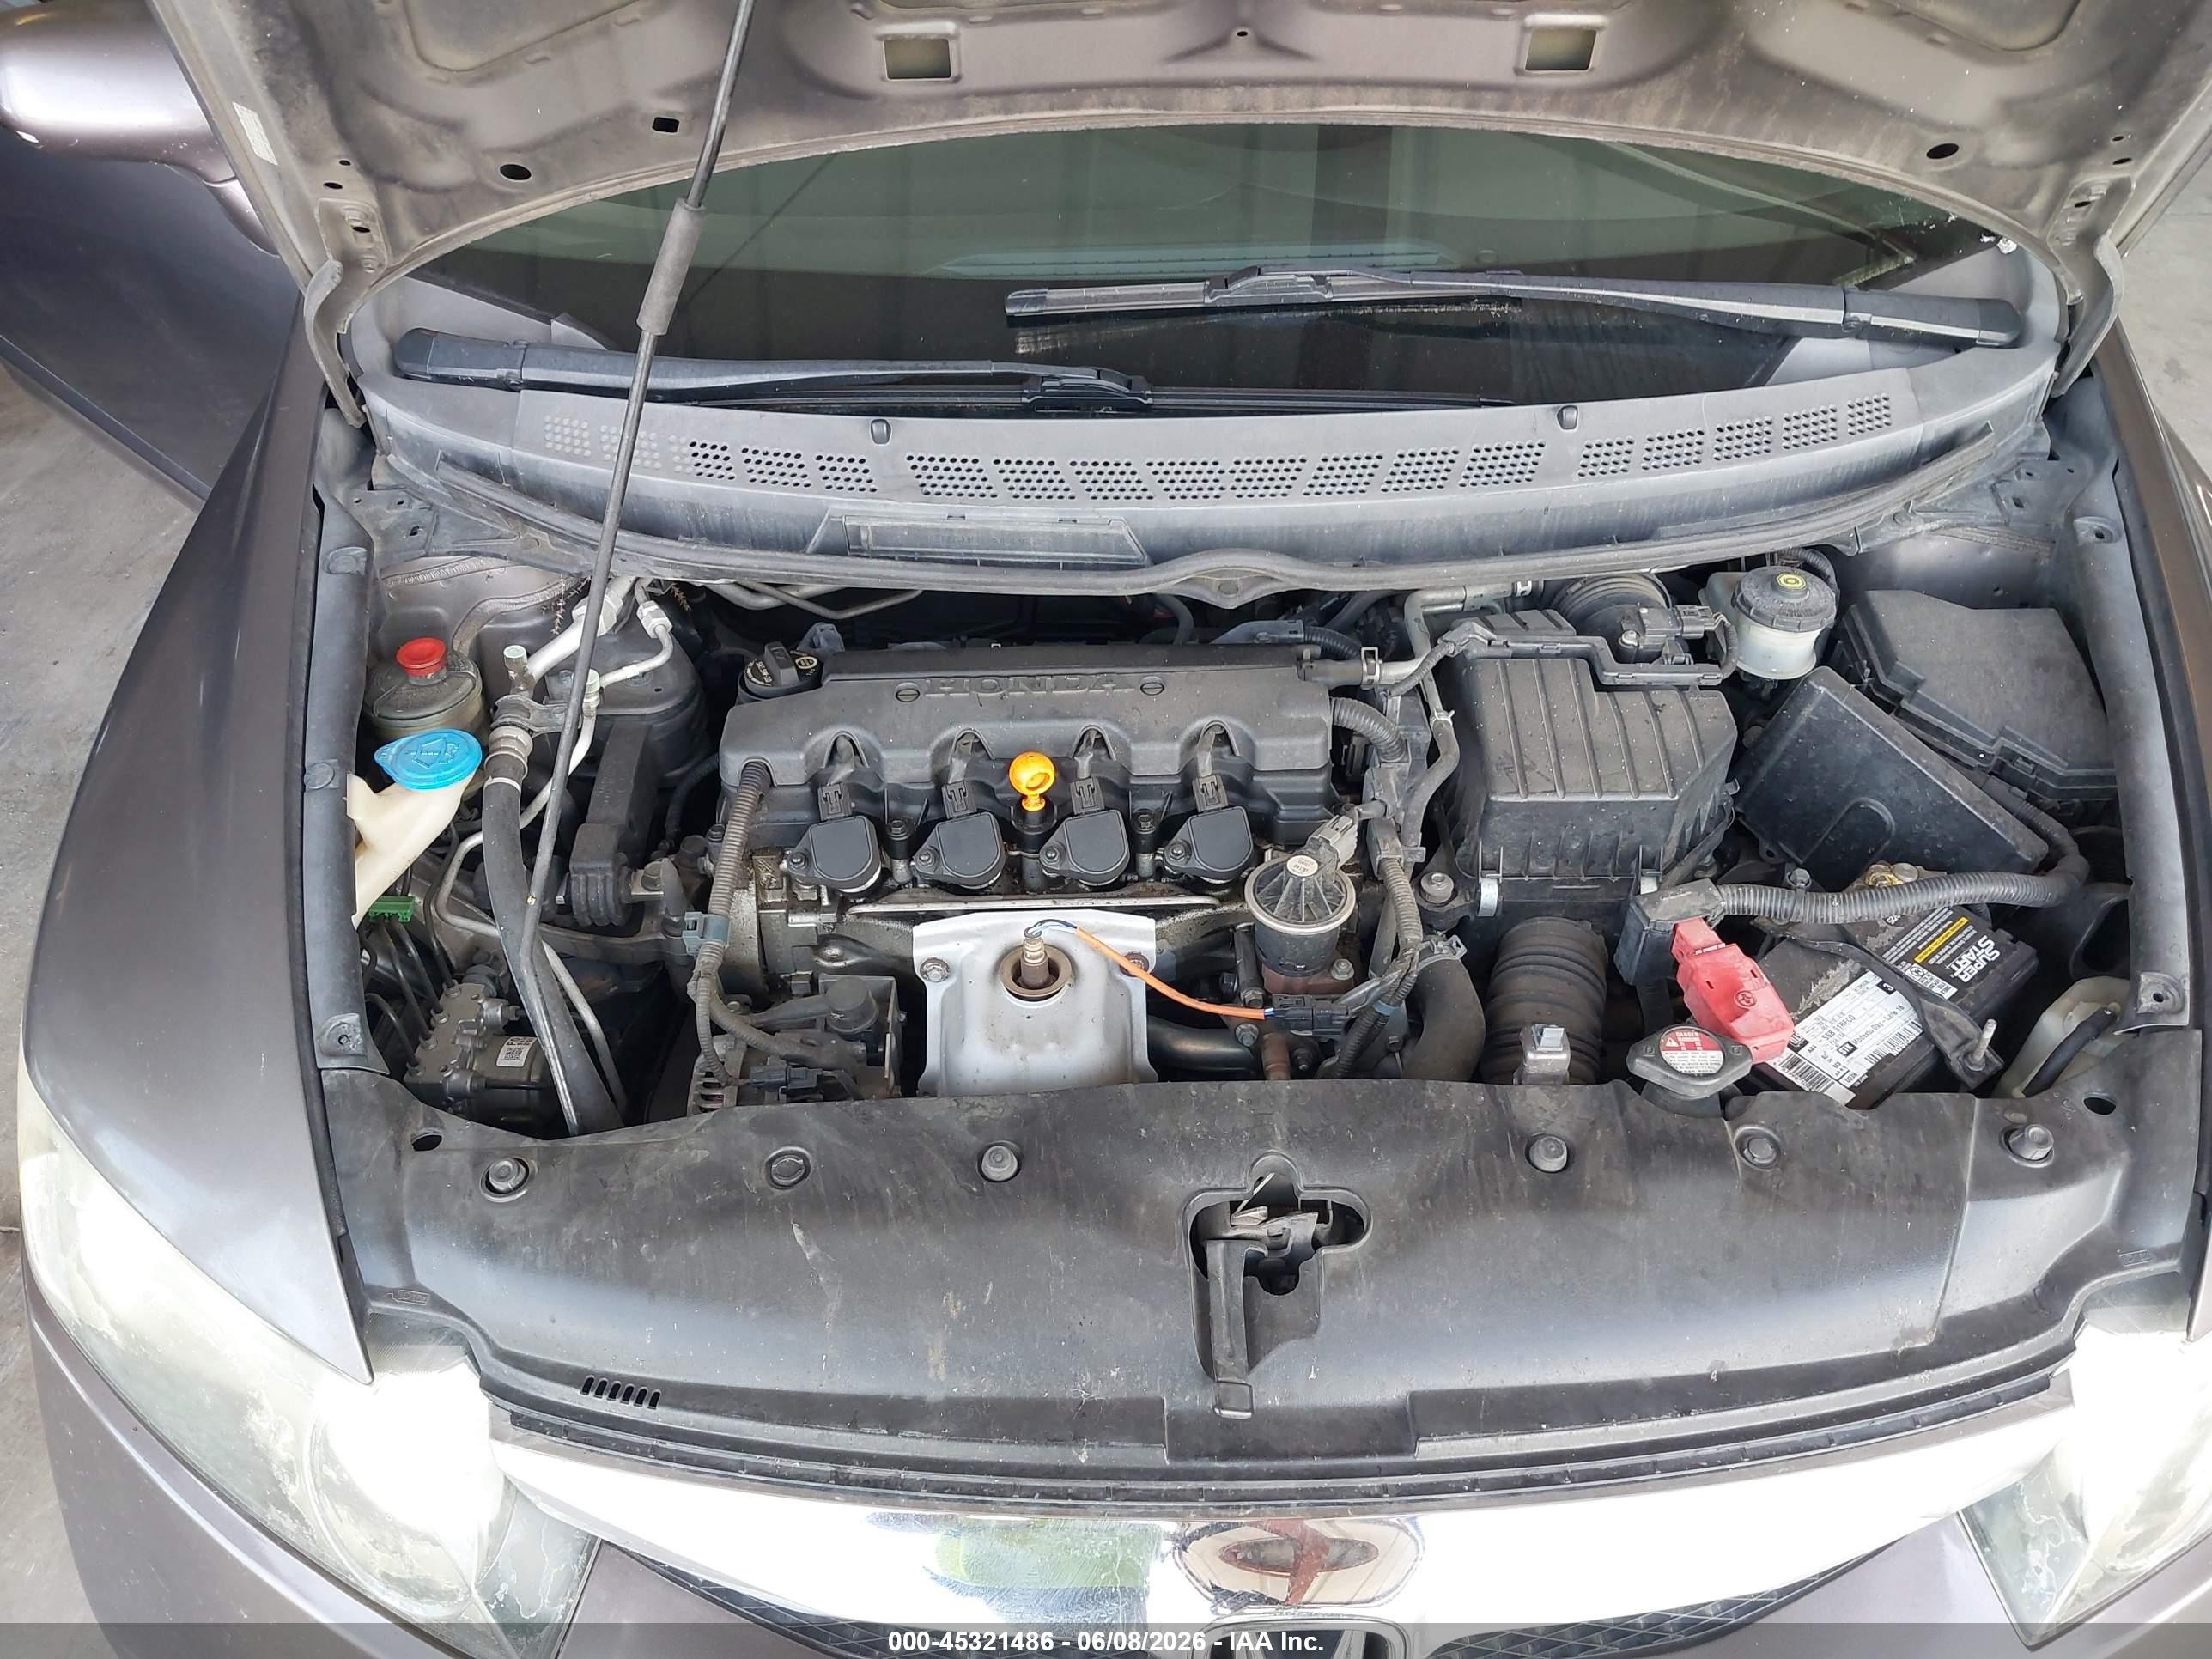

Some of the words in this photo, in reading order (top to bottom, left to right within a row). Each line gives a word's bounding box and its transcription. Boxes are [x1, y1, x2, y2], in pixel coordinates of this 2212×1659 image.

[926, 676, 1135, 697] HONDA
[1949, 934, 1995, 976] START
[1957, 948, 2001, 983] SUPER
